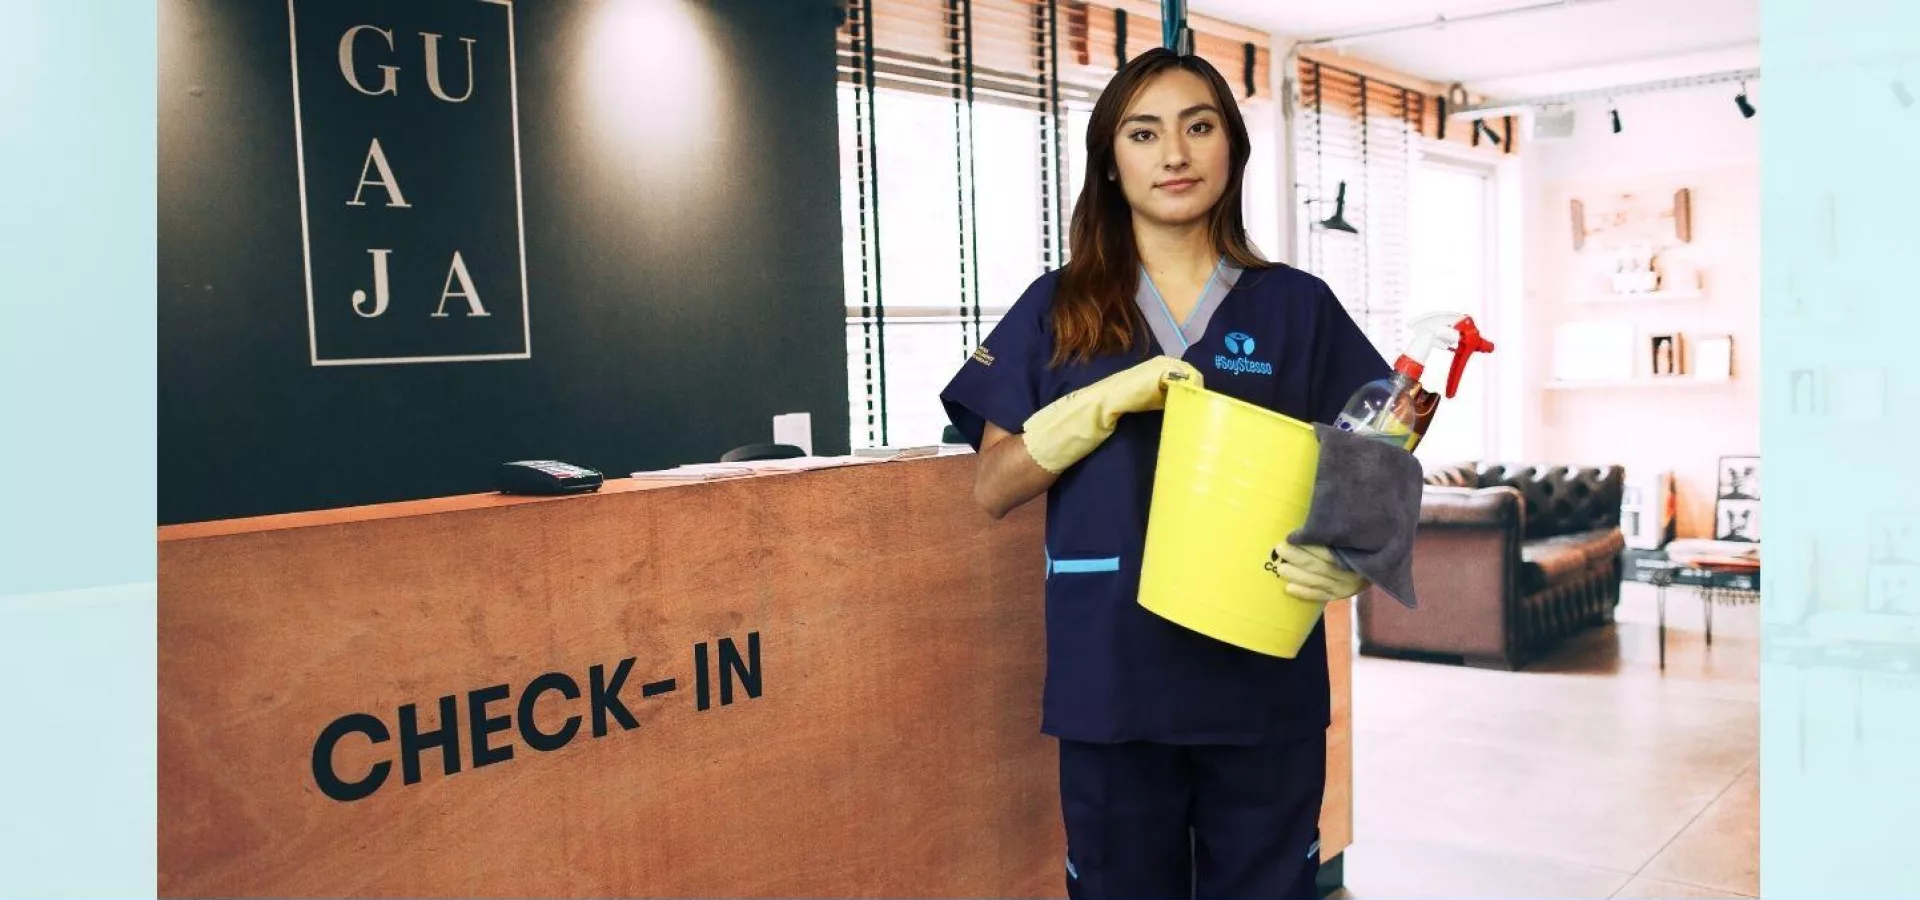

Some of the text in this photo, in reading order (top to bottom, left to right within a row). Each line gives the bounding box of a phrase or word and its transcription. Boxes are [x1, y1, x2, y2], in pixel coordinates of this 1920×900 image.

[338, 25, 478, 102] GU
[346, 138, 412, 208] A
[1215, 354, 1273, 375] #SoyStesso
